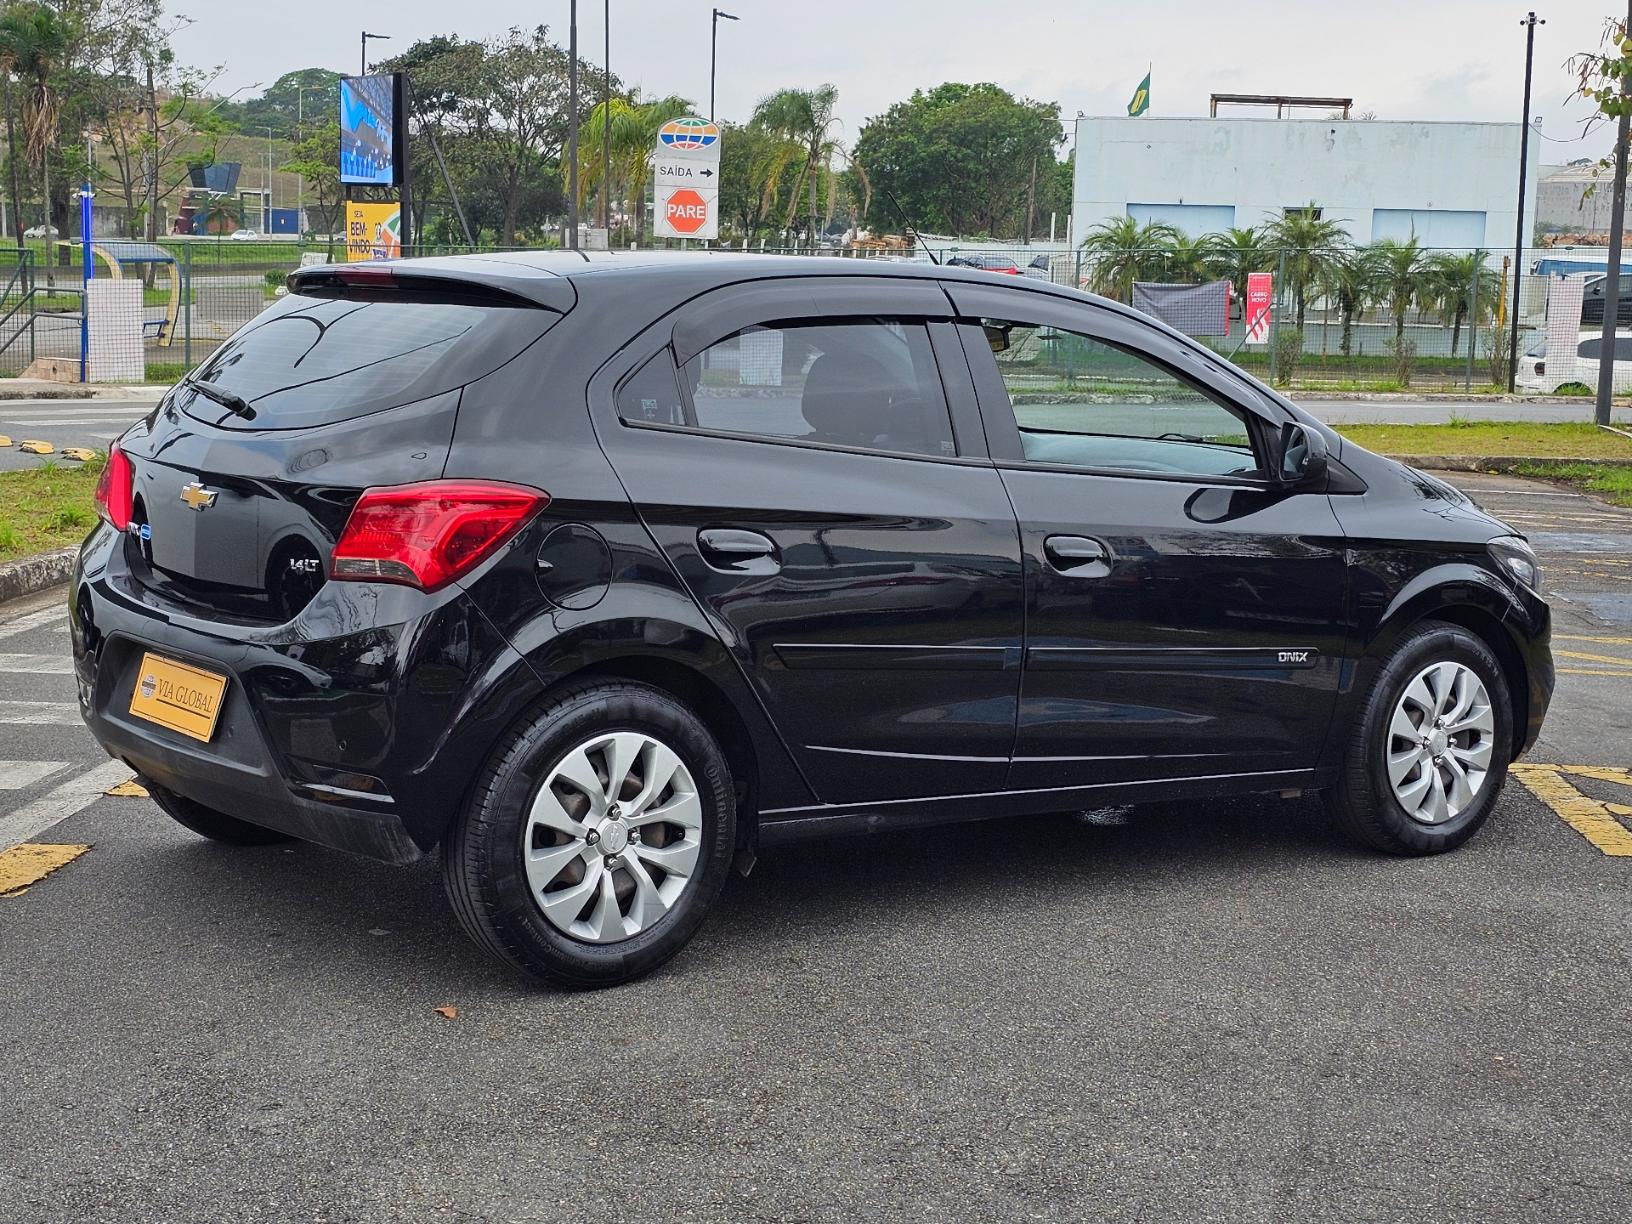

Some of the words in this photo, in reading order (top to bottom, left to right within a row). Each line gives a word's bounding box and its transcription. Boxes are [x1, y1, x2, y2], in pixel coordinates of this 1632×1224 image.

[660, 164, 692, 178] SAÍDA
[667, 204, 705, 219] PARE
[351, 222, 367, 236] BEM-
[349, 239, 370, 254] VINDO
[159, 678, 173, 699] VIA
[175, 686, 213, 712] GLOBAL
